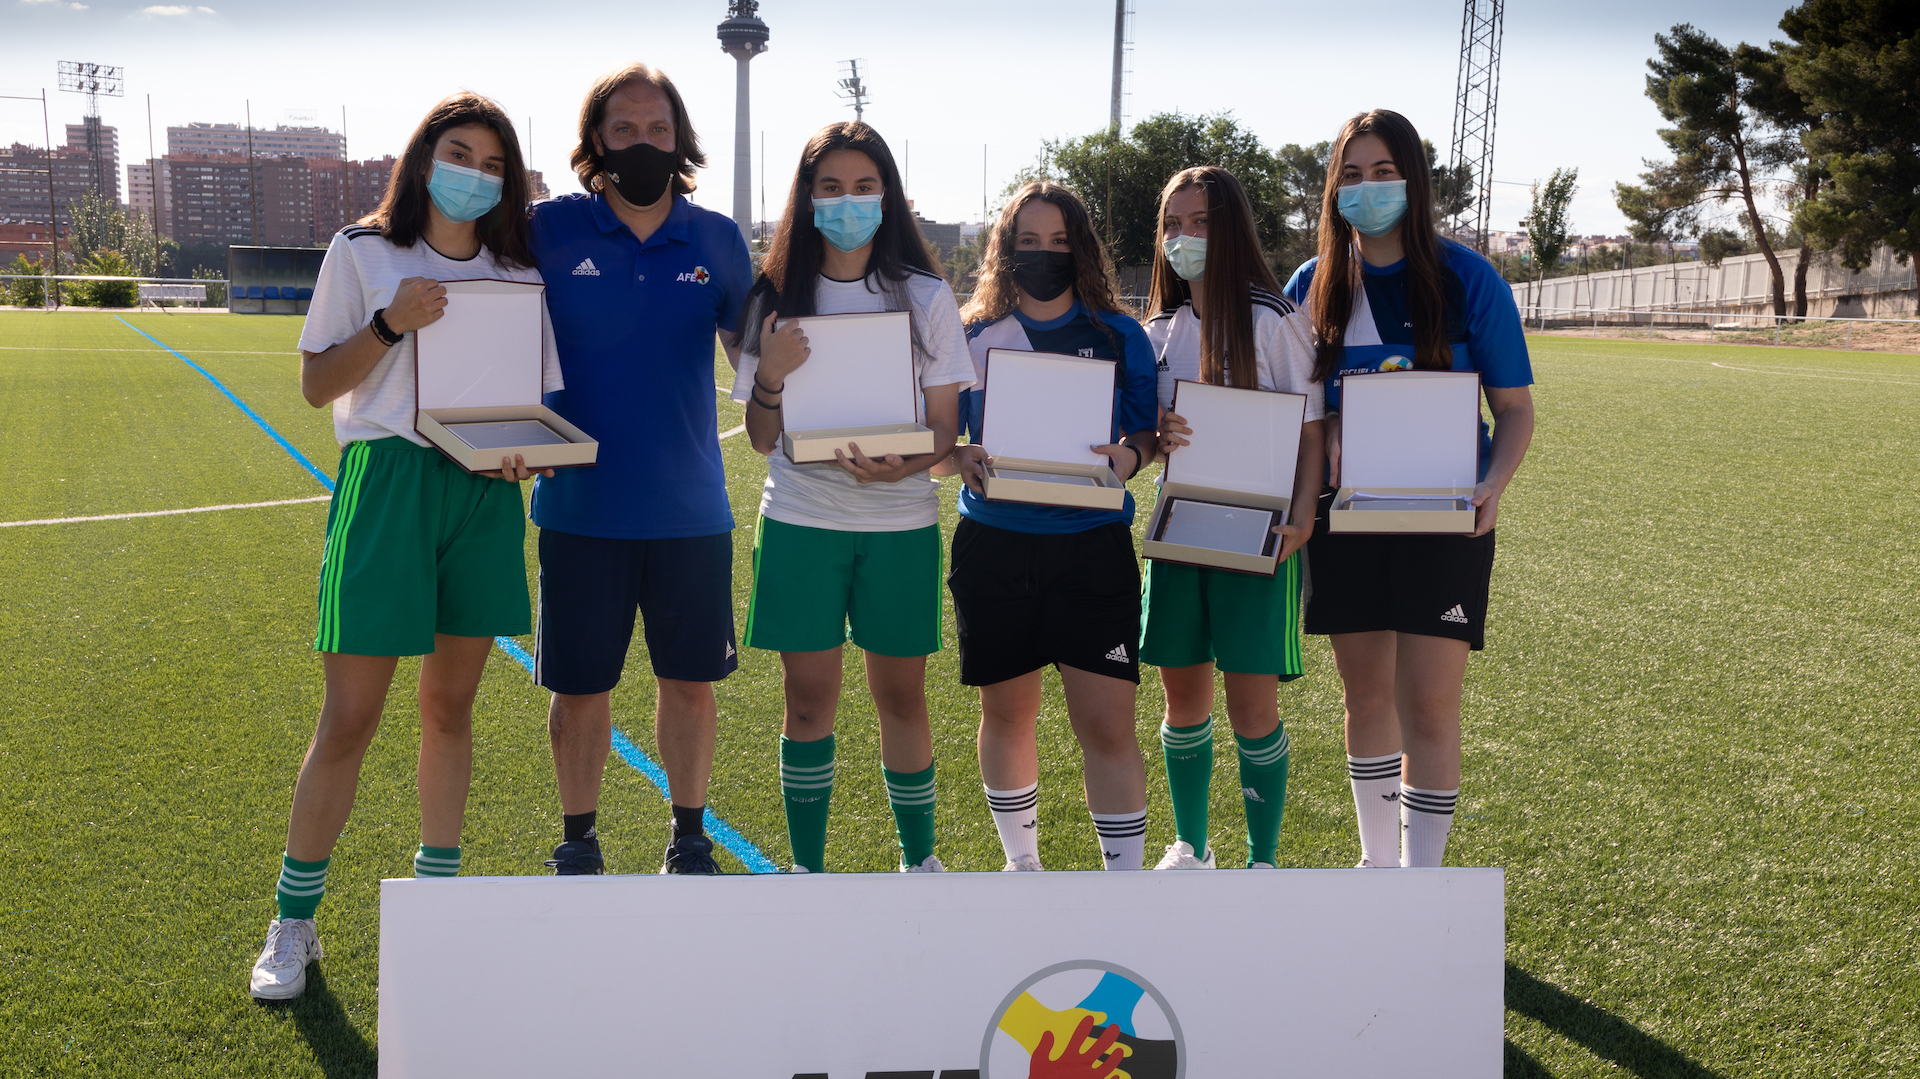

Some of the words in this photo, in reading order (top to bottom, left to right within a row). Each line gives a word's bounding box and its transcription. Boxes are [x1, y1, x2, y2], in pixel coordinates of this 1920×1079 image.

[572, 268, 600, 276] adidas
[676, 272, 696, 282] AFE
[1440, 614, 1468, 624] adidas
[1105, 653, 1130, 664] adidas
